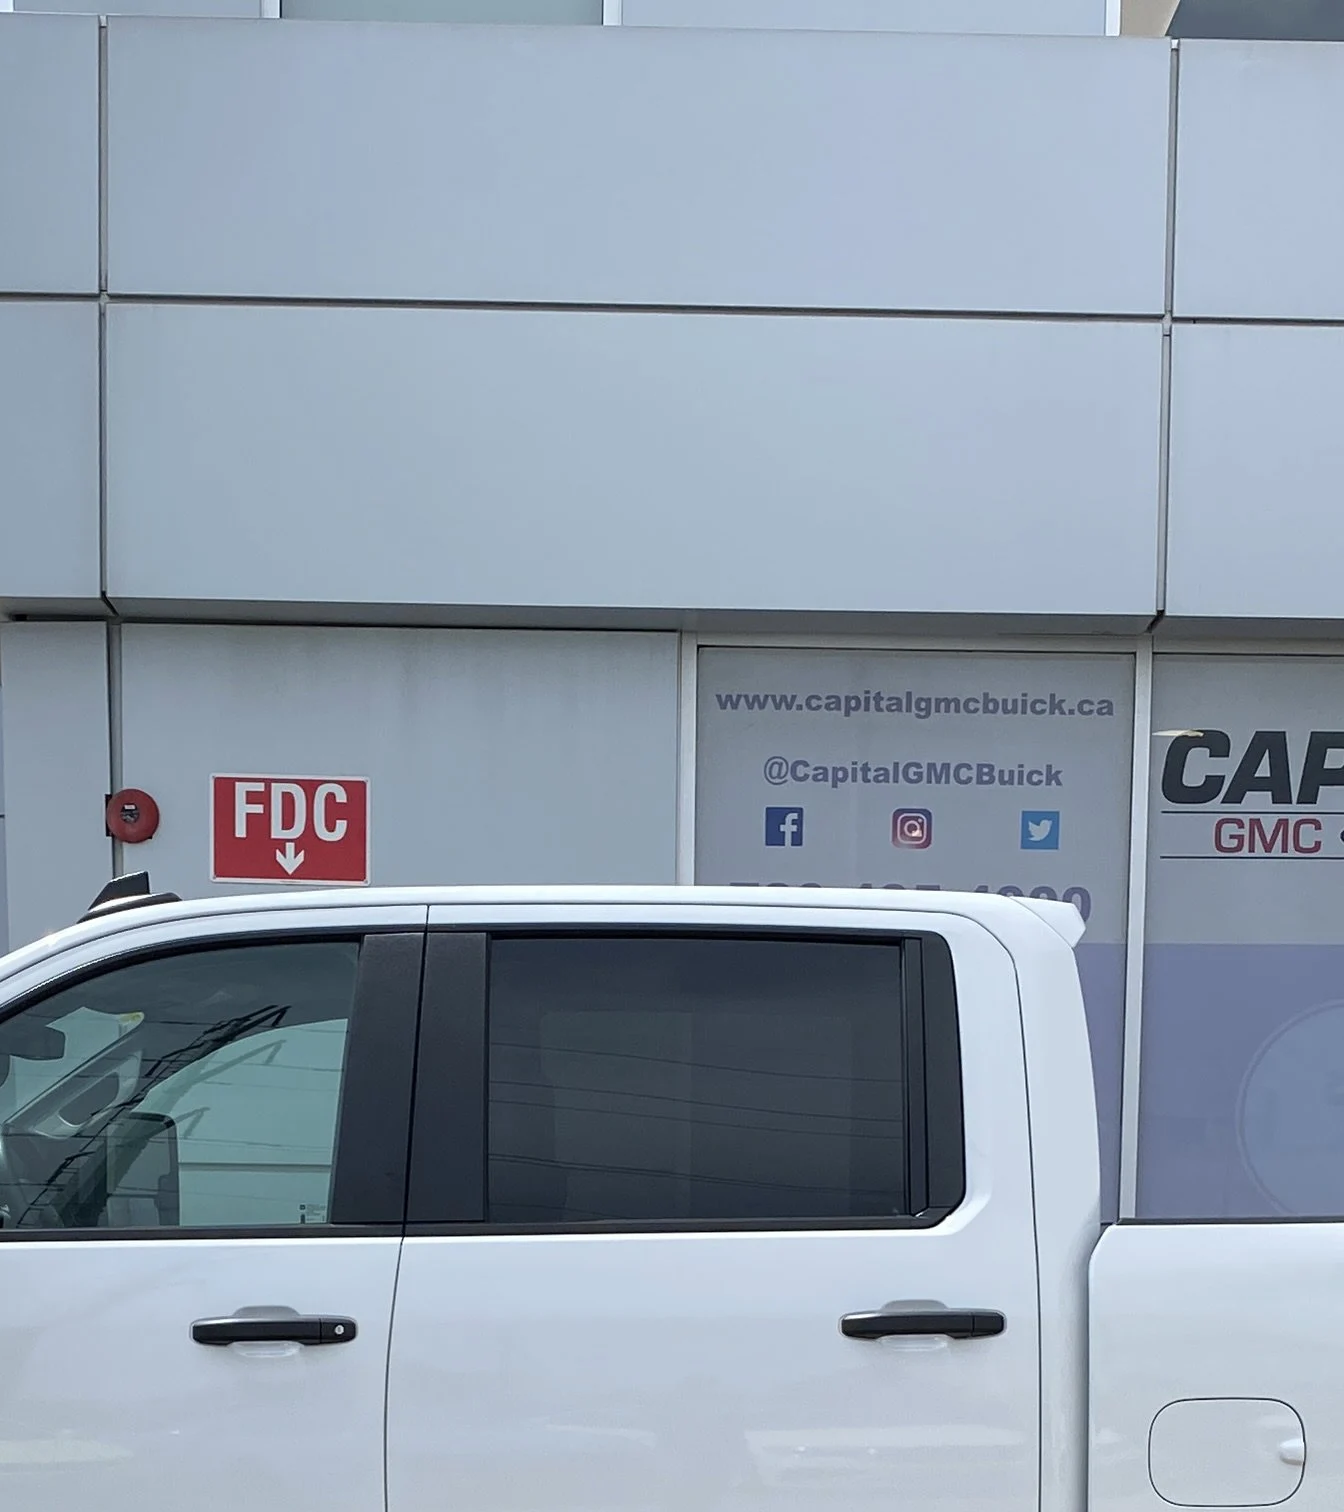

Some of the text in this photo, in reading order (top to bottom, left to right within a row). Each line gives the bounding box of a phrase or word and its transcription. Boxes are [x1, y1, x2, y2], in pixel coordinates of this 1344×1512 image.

[715, 689, 1115, 719] www.capitalgmcbuick.ca
[763, 755, 1063, 788] @CapitalGMCBuick
[234, 781, 348, 842] FDC
[1213, 817, 1323, 854] GMC
